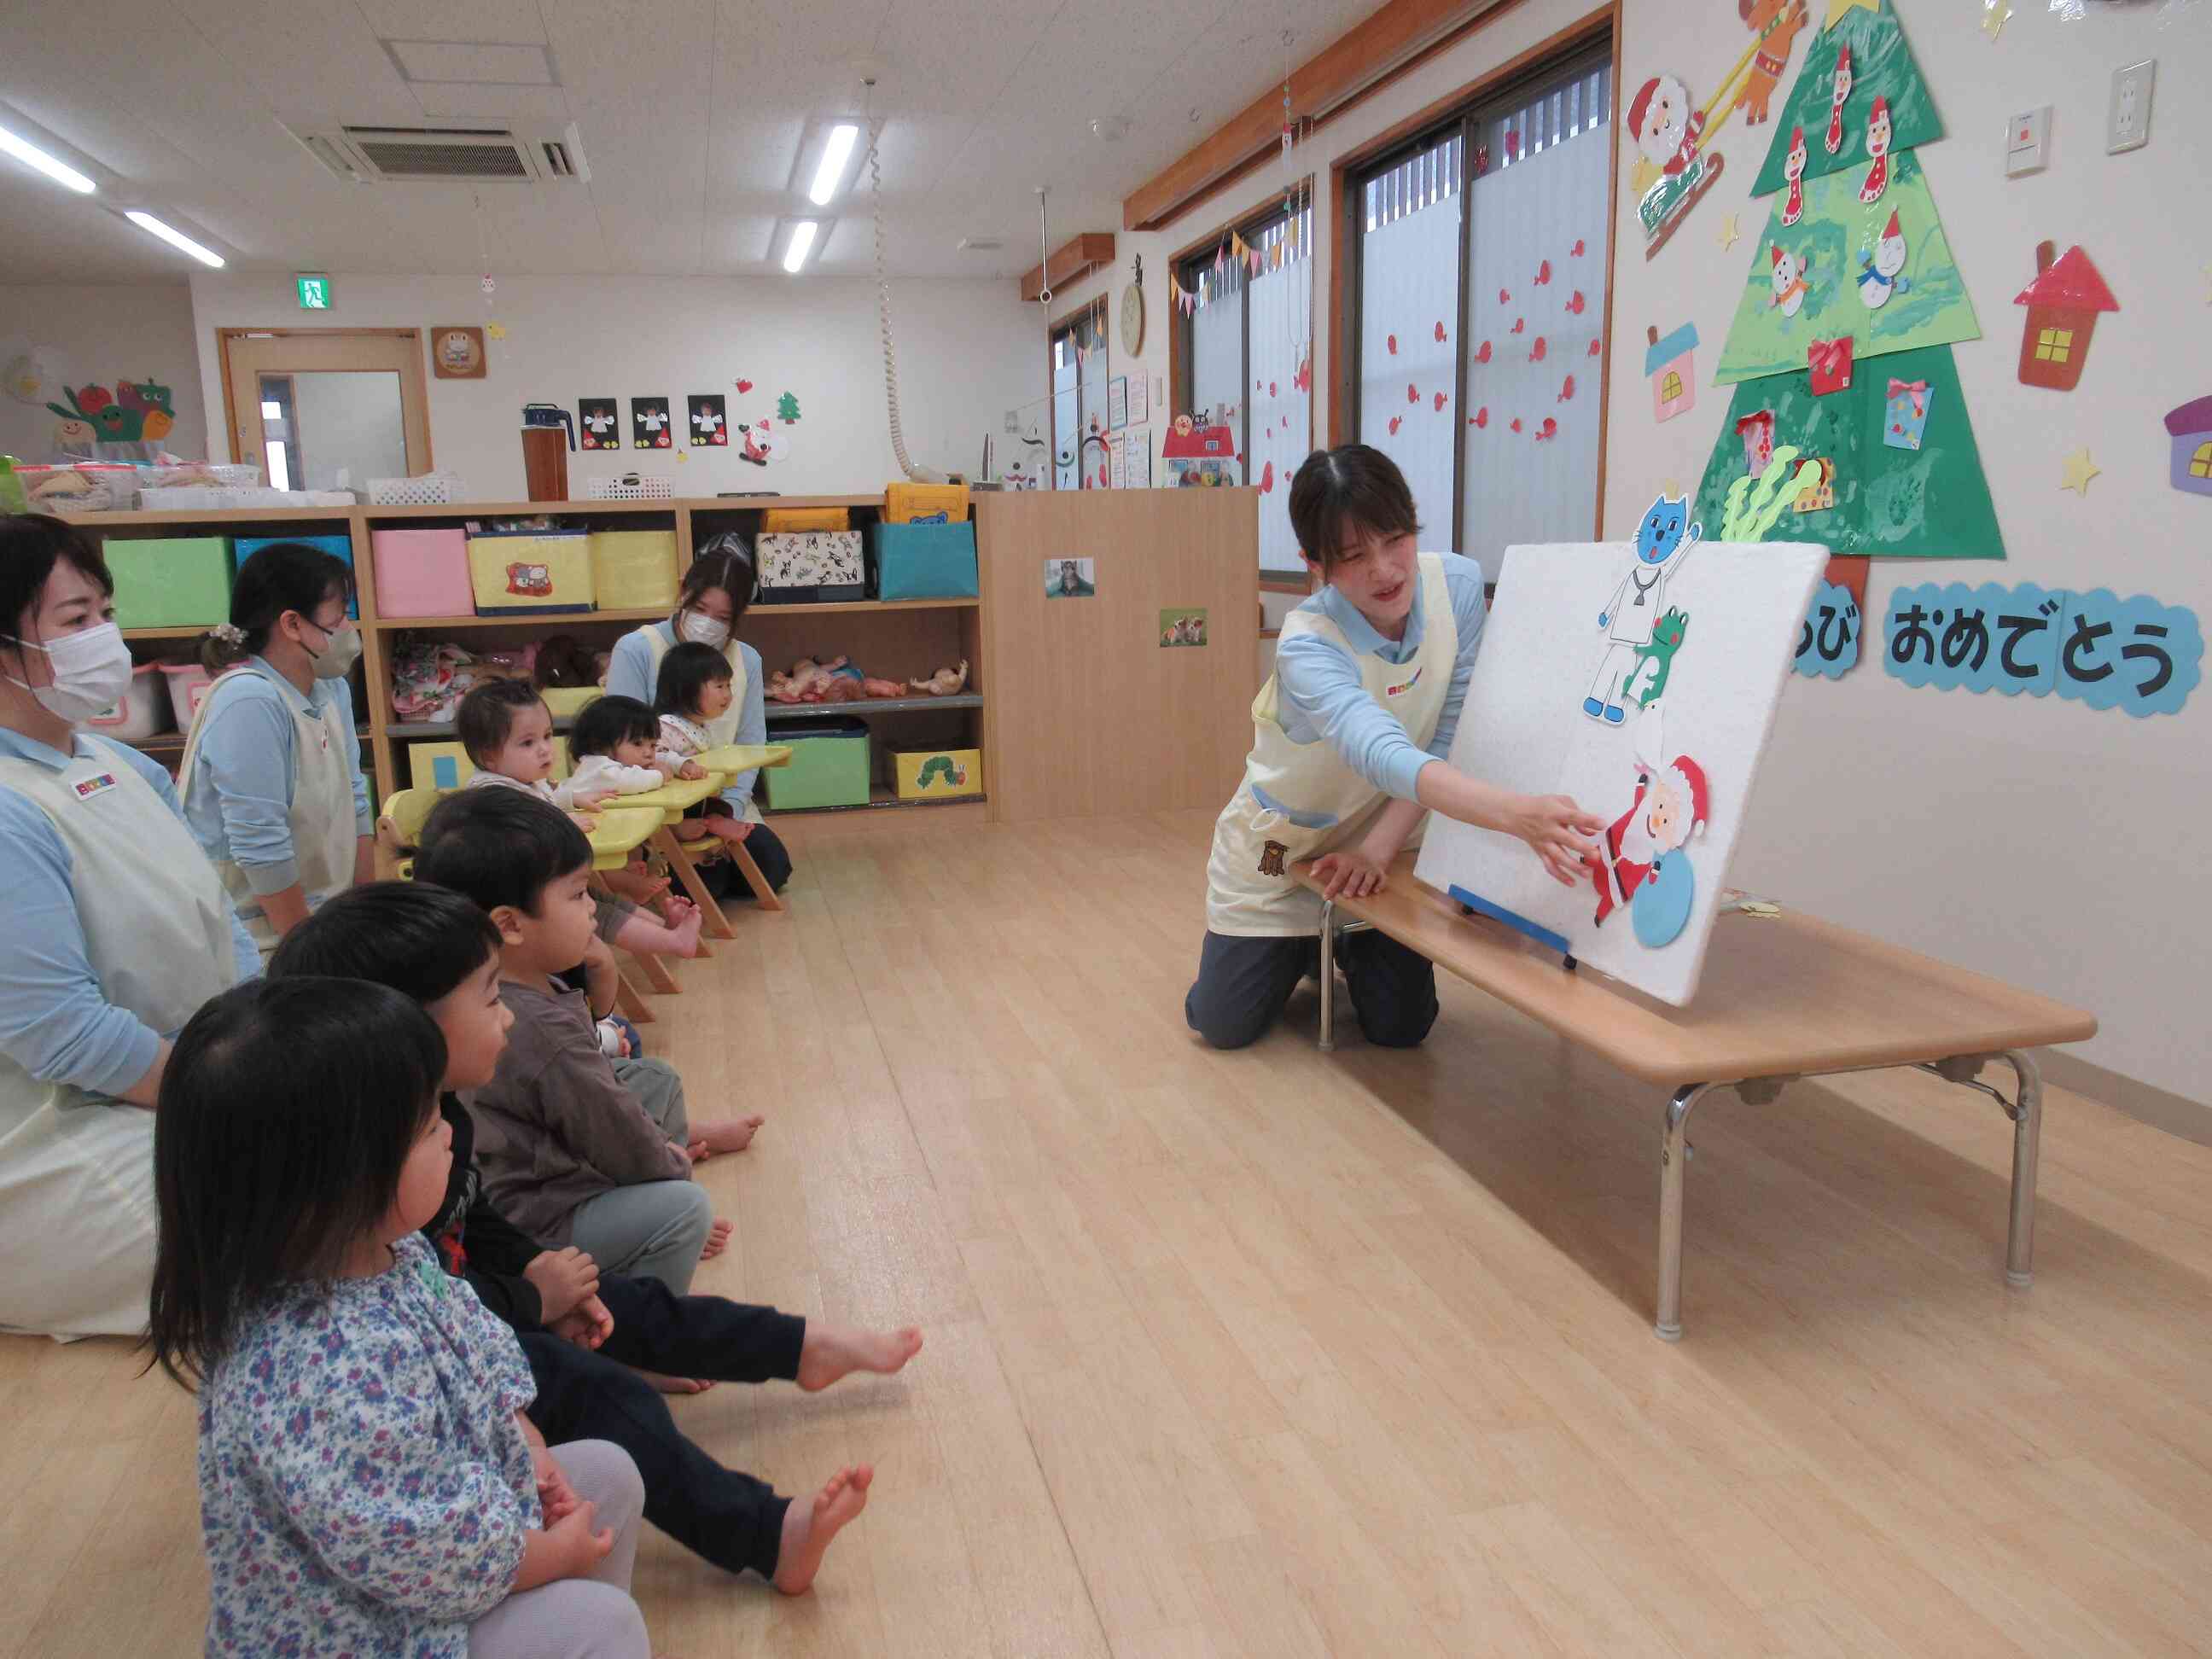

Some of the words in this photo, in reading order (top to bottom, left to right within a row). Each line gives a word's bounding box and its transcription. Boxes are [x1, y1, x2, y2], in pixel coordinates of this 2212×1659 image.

[1891, 600, 2173, 697] おめでとう
